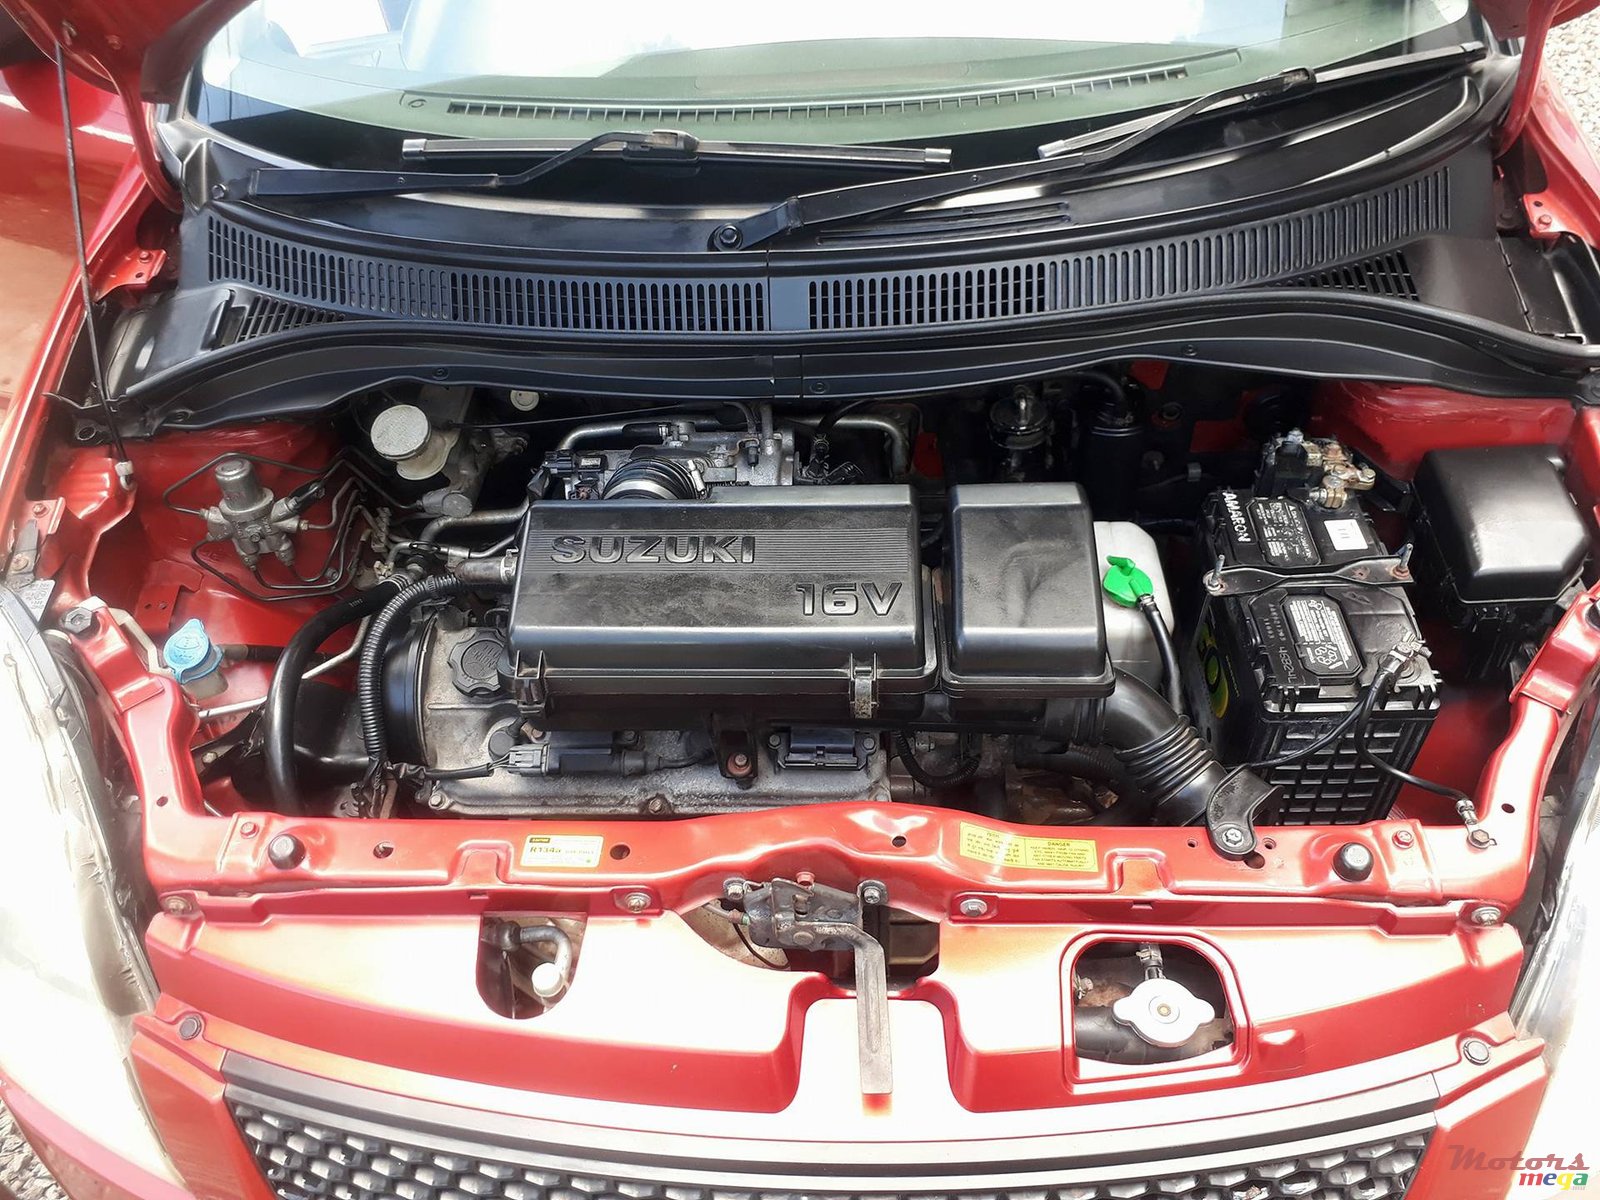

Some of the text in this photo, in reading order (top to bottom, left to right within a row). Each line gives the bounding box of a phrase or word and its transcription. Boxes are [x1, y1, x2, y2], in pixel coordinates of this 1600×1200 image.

[1222, 491, 1252, 543] AMARON
[550, 534, 757, 565] SUZUKI
[796, 581, 903, 617] 16V
